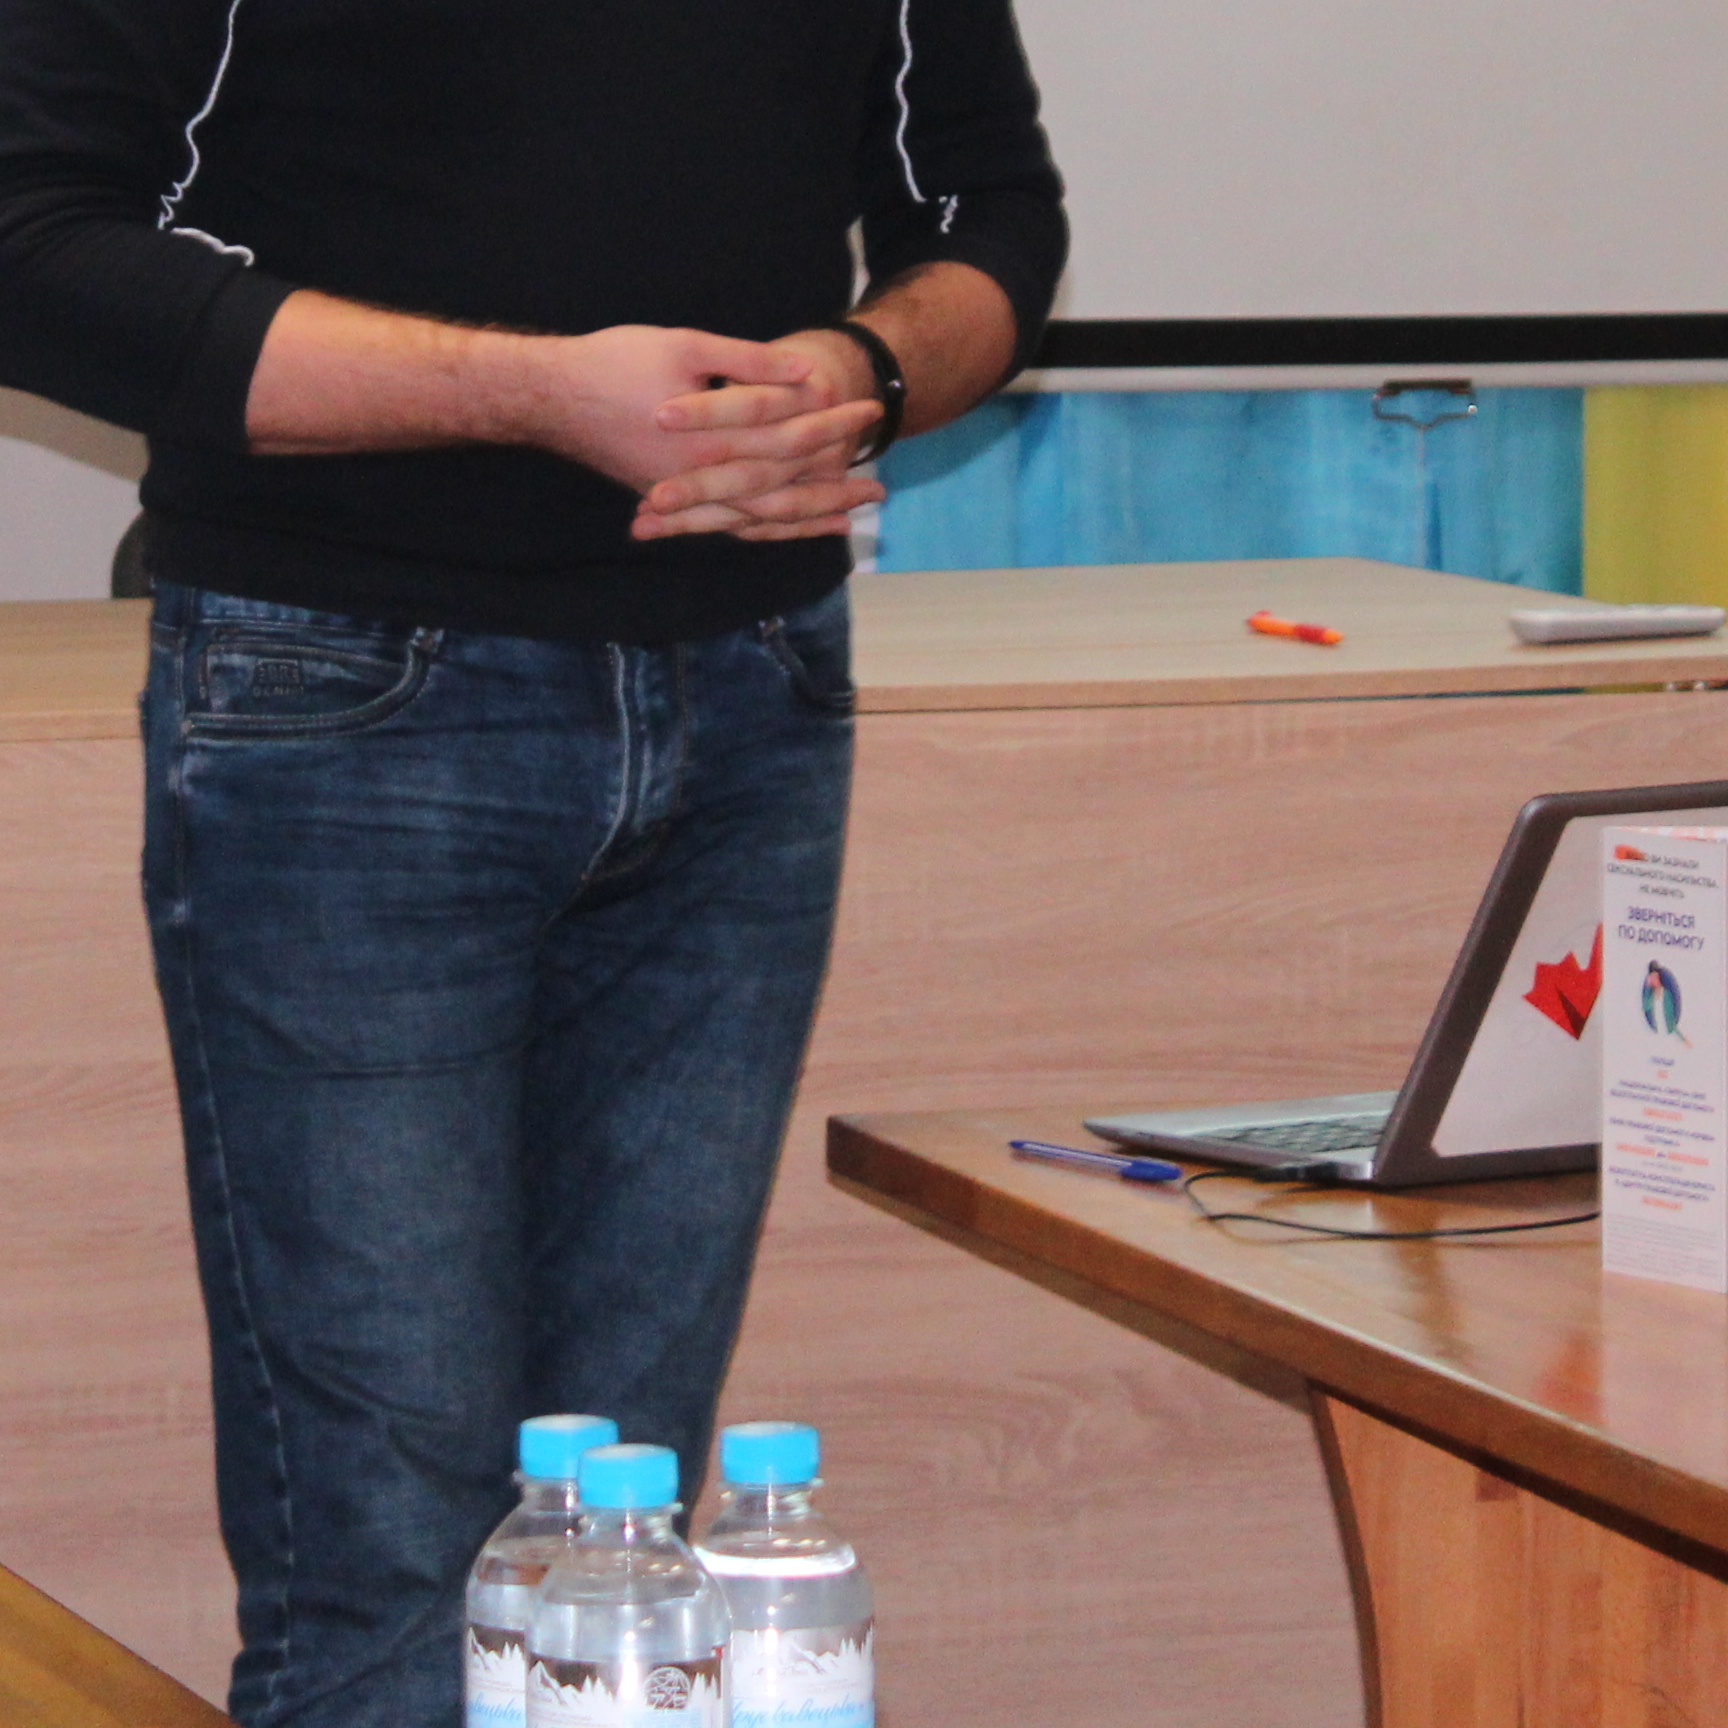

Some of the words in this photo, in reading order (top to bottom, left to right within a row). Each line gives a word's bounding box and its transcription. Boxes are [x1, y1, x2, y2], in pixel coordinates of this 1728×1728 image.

[1628, 906, 1695, 929] ЗВЕРНІТЬСЯ
[1618, 924, 1635, 940] ПО
[1638, 928, 1705, 951] ДОПОМОГУ
